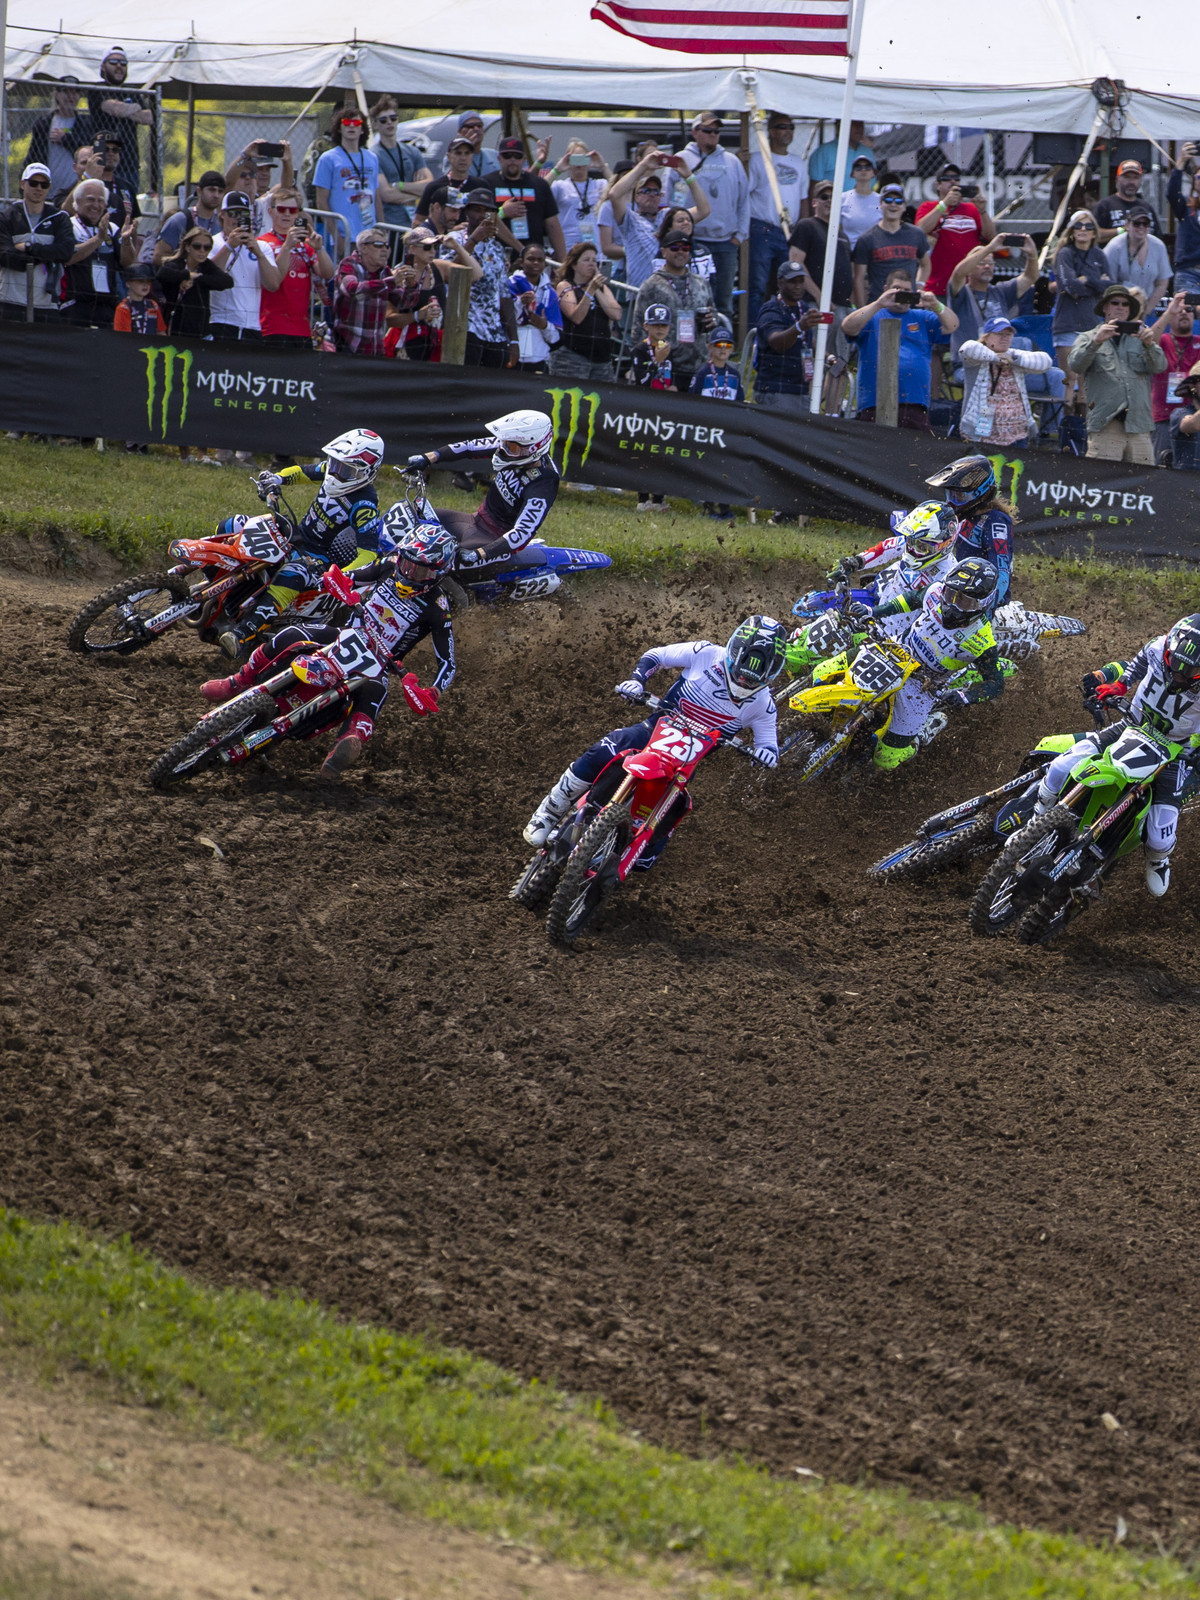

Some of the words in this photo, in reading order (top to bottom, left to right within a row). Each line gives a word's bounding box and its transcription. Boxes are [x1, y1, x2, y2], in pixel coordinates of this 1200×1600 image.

[213, 398, 297, 414] ENERGY
[618, 439, 706, 460] ENERGY
[508, 498, 544, 544] CANVAS
[1044, 507, 1135, 527] ENERGY
[242, 521, 280, 561] 746
[514, 577, 549, 598] 522
[376, 584, 418, 623] GASGAS
[332, 633, 377, 675] 51
[404, 684, 424, 711] ACERBIS
[1143, 673, 1195, 721] FLY
[249, 729, 275, 747] DUNLOP
[650, 727, 704, 762] 23
[1112, 737, 1164, 770] 17
[940, 799, 980, 821] DUNLOP
[1161, 822, 1174, 839] FLY
[1053, 849, 1082, 882] DUNLOP
